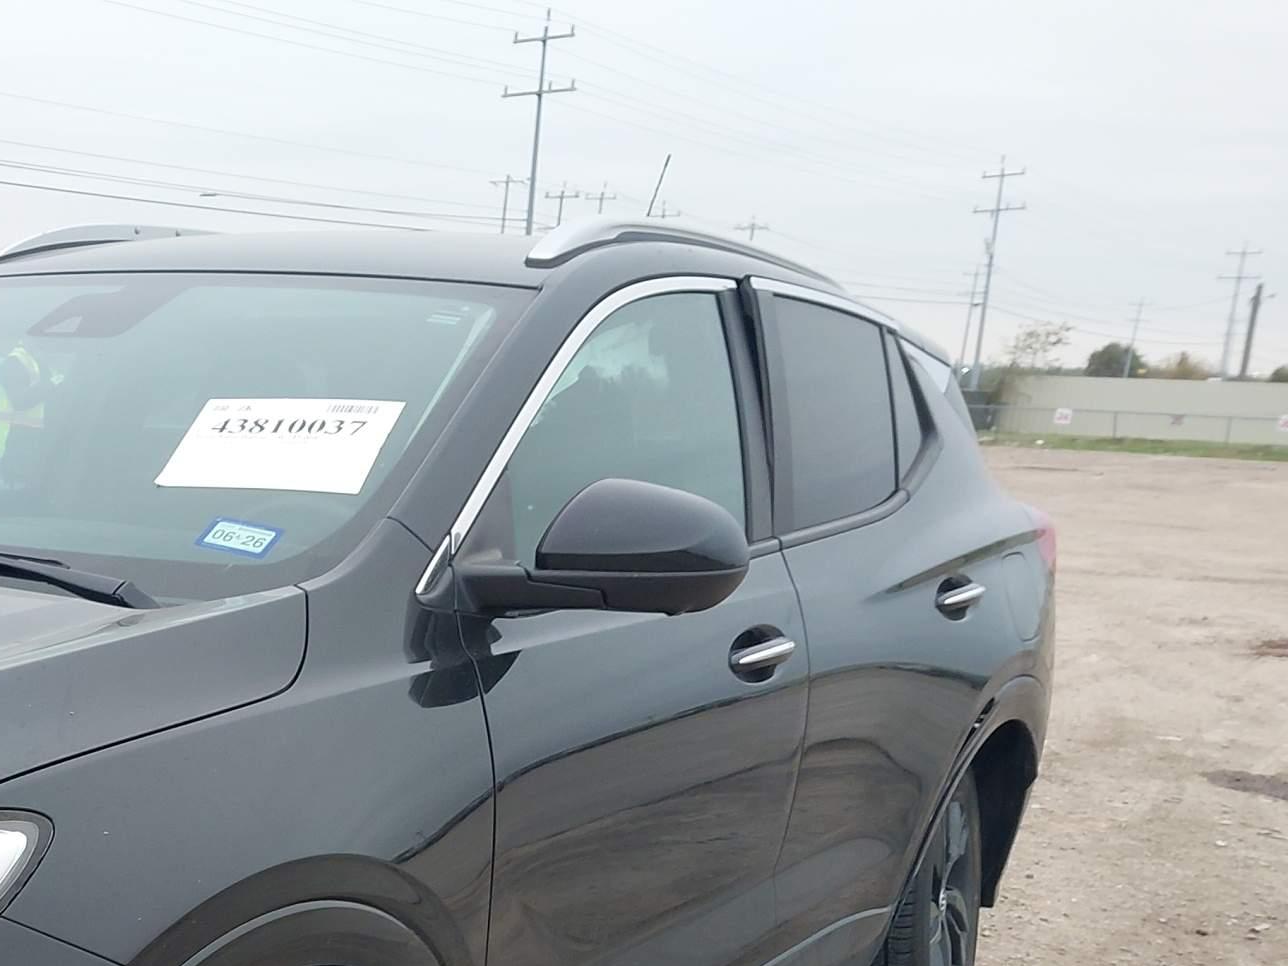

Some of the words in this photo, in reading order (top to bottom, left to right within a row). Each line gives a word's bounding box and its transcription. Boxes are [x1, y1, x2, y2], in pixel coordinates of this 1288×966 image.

[211, 417, 368, 436] 43810037
[212, 528, 236, 542] 06
[240, 535, 266, 548] 26
